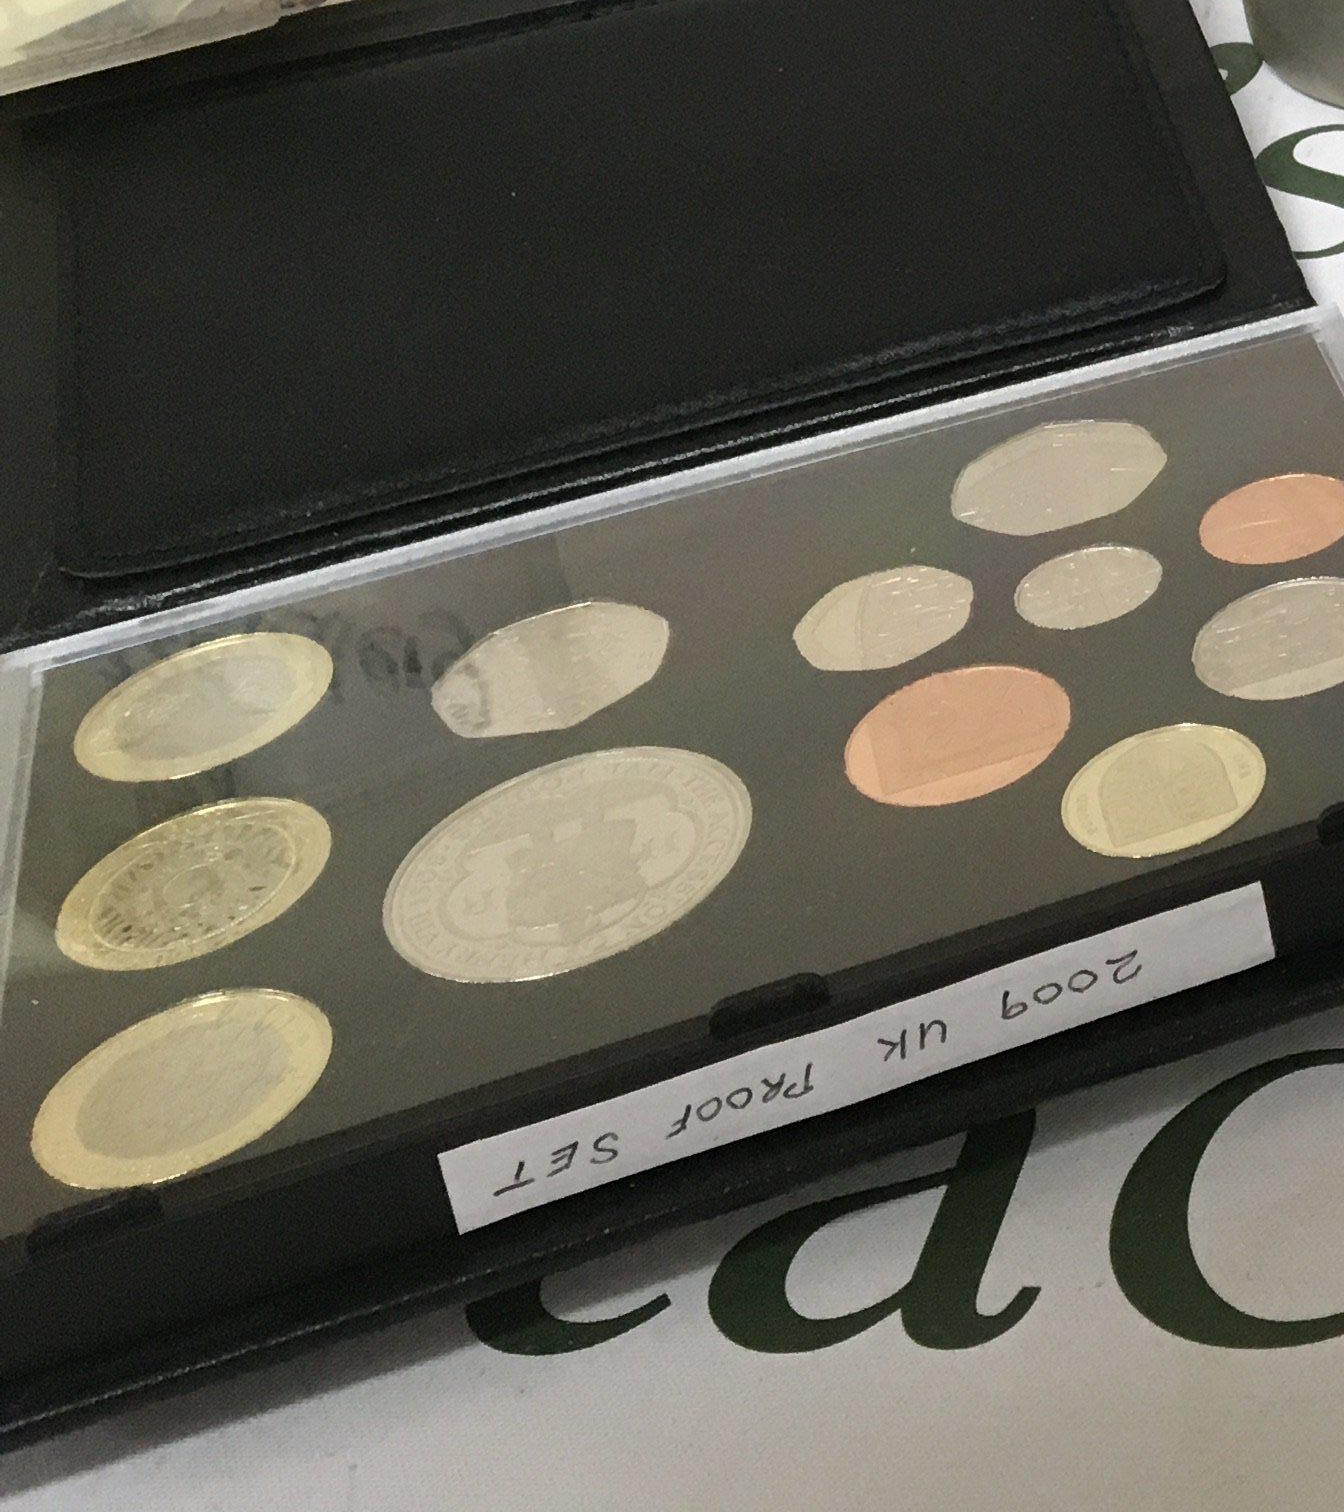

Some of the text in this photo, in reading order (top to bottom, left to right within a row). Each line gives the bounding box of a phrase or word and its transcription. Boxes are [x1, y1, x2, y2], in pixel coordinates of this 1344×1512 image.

[493, 949, 1143, 1198] 2009 UK PROOF SET
